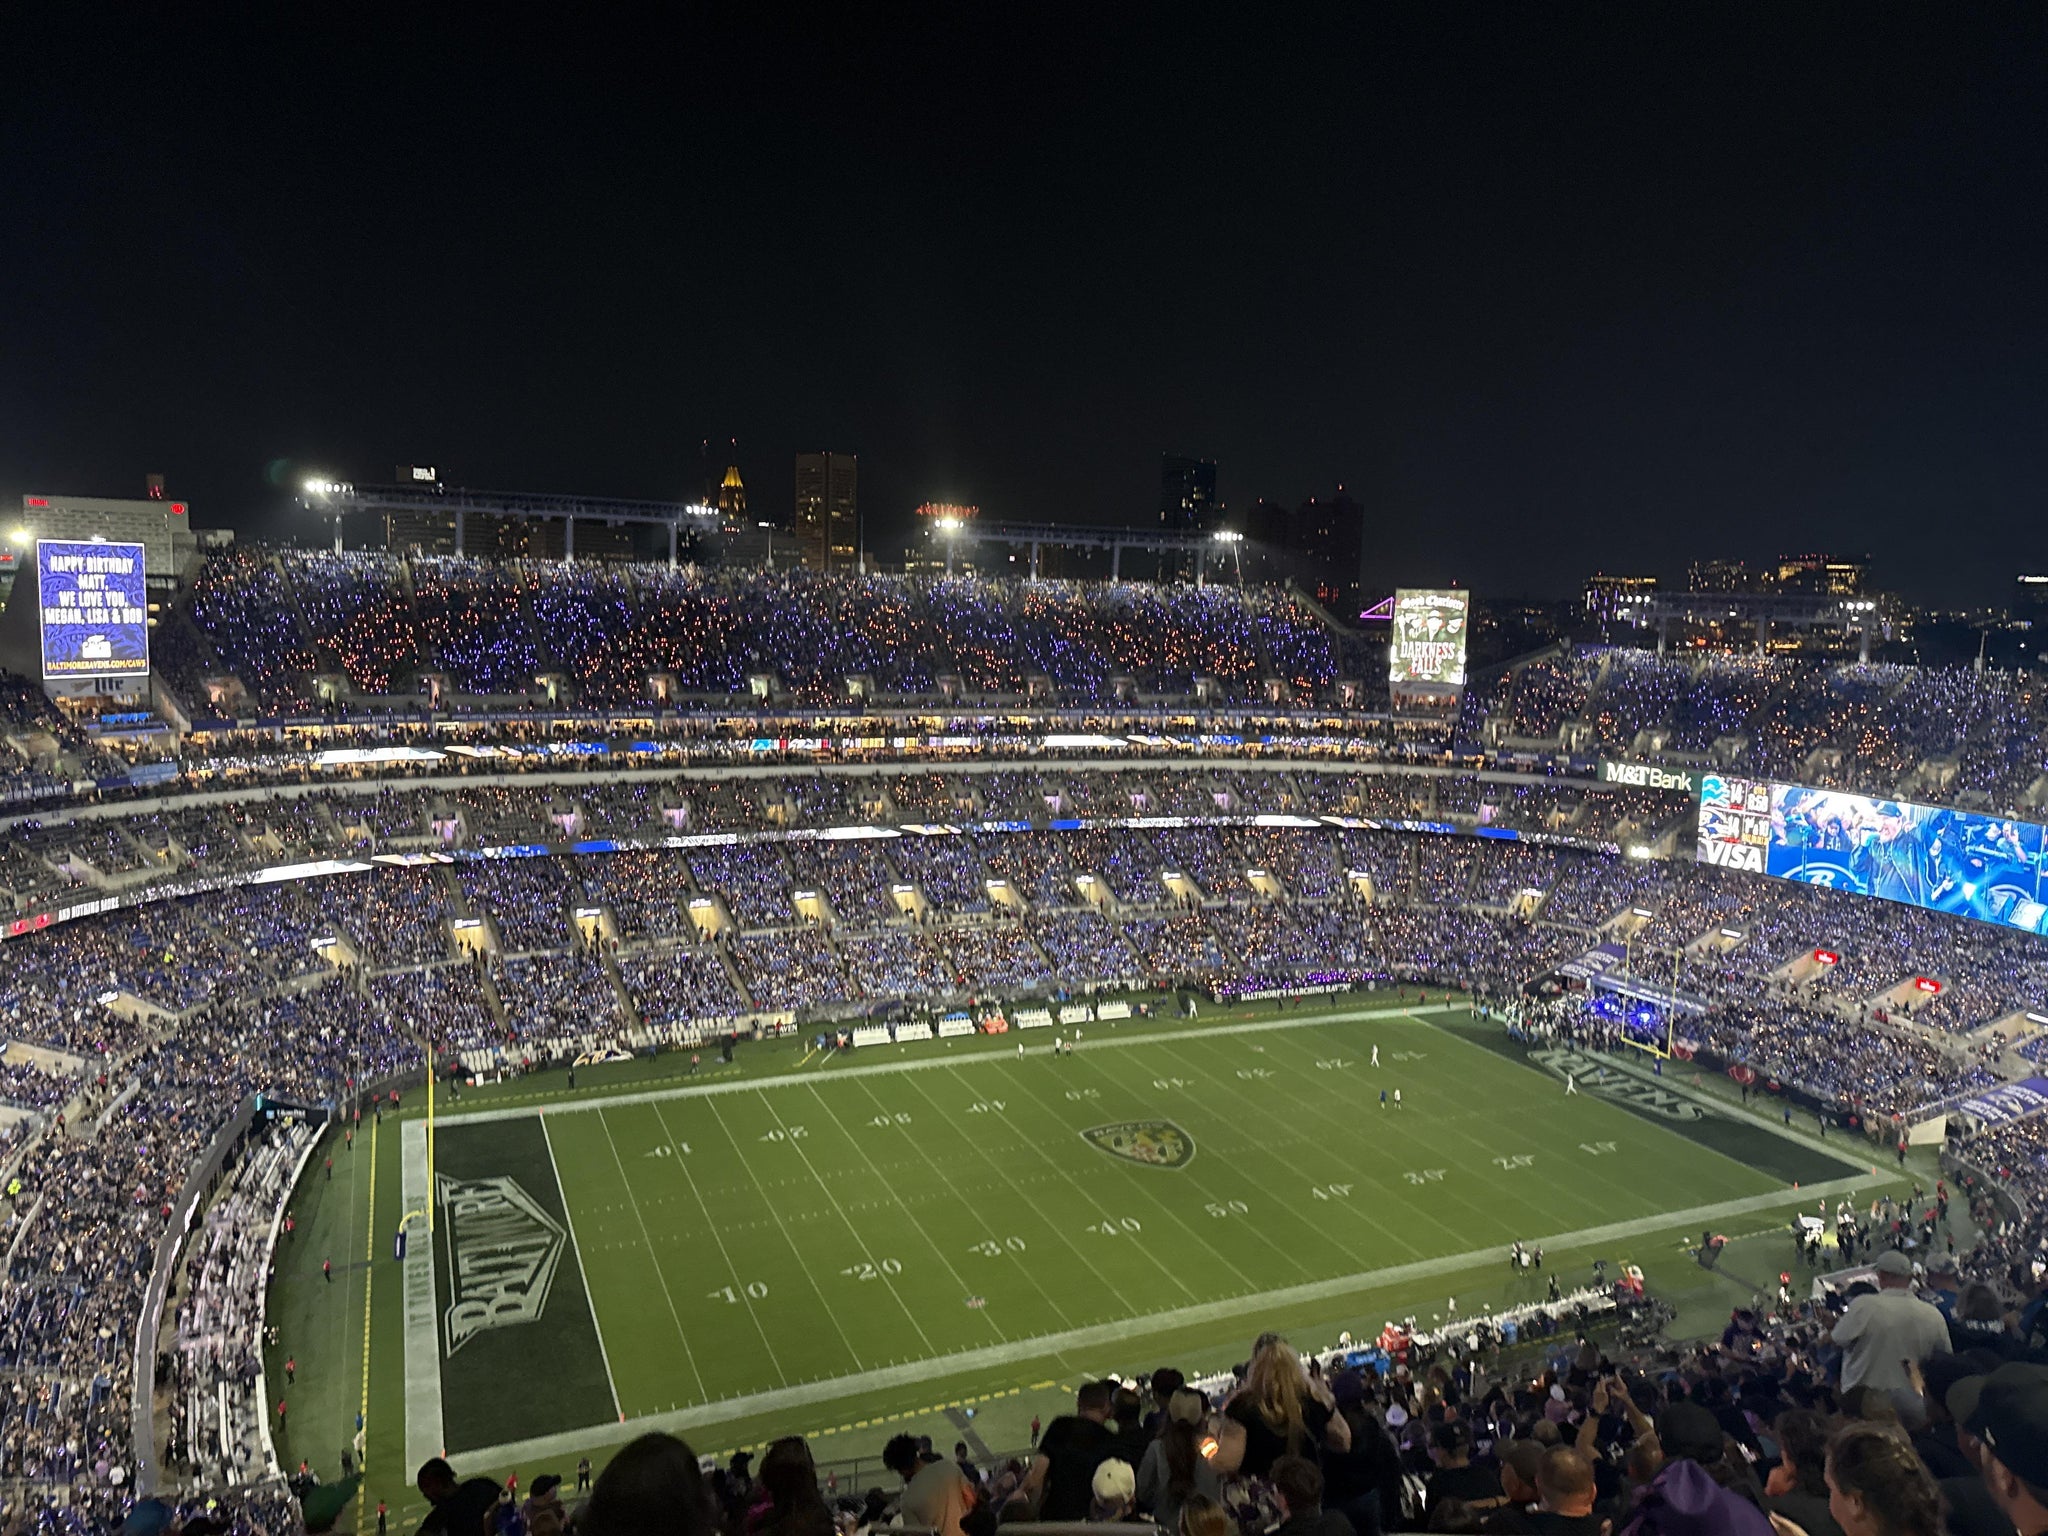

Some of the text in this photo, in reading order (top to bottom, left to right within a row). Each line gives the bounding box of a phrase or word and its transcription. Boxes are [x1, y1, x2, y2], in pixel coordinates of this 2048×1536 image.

[50, 556, 134, 573] HAPPY BIRTHDAY
[59, 591, 76, 607] WE
[78, 591, 103, 607] LOVE
[87, 608, 109, 624] LISA
[112, 608, 120, 624] &
[1400, 641, 1456, 660] DARKNESS
[1411, 656, 1443, 674] FALLS
[1606, 762, 1693, 792] M&T Bank
[667, 834, 737, 847] RAVENS
[1701, 840, 1763, 873] VISA
[58, 896, 119, 922] AND NOTHING MORE
[1288, 985, 1325, 997] MARCHING
[1527, 1050, 1703, 1122] RAVENS
[1204, 1200, 1249, 1218] 50
[1101, 1216, 1141, 1235] 40
[980, 1236, 1026, 1257] 30
[440, 1176, 562, 1346] BALTIMORE
[853, 1258, 902, 1281] 20
[721, 1281, 768, 1304] 10
